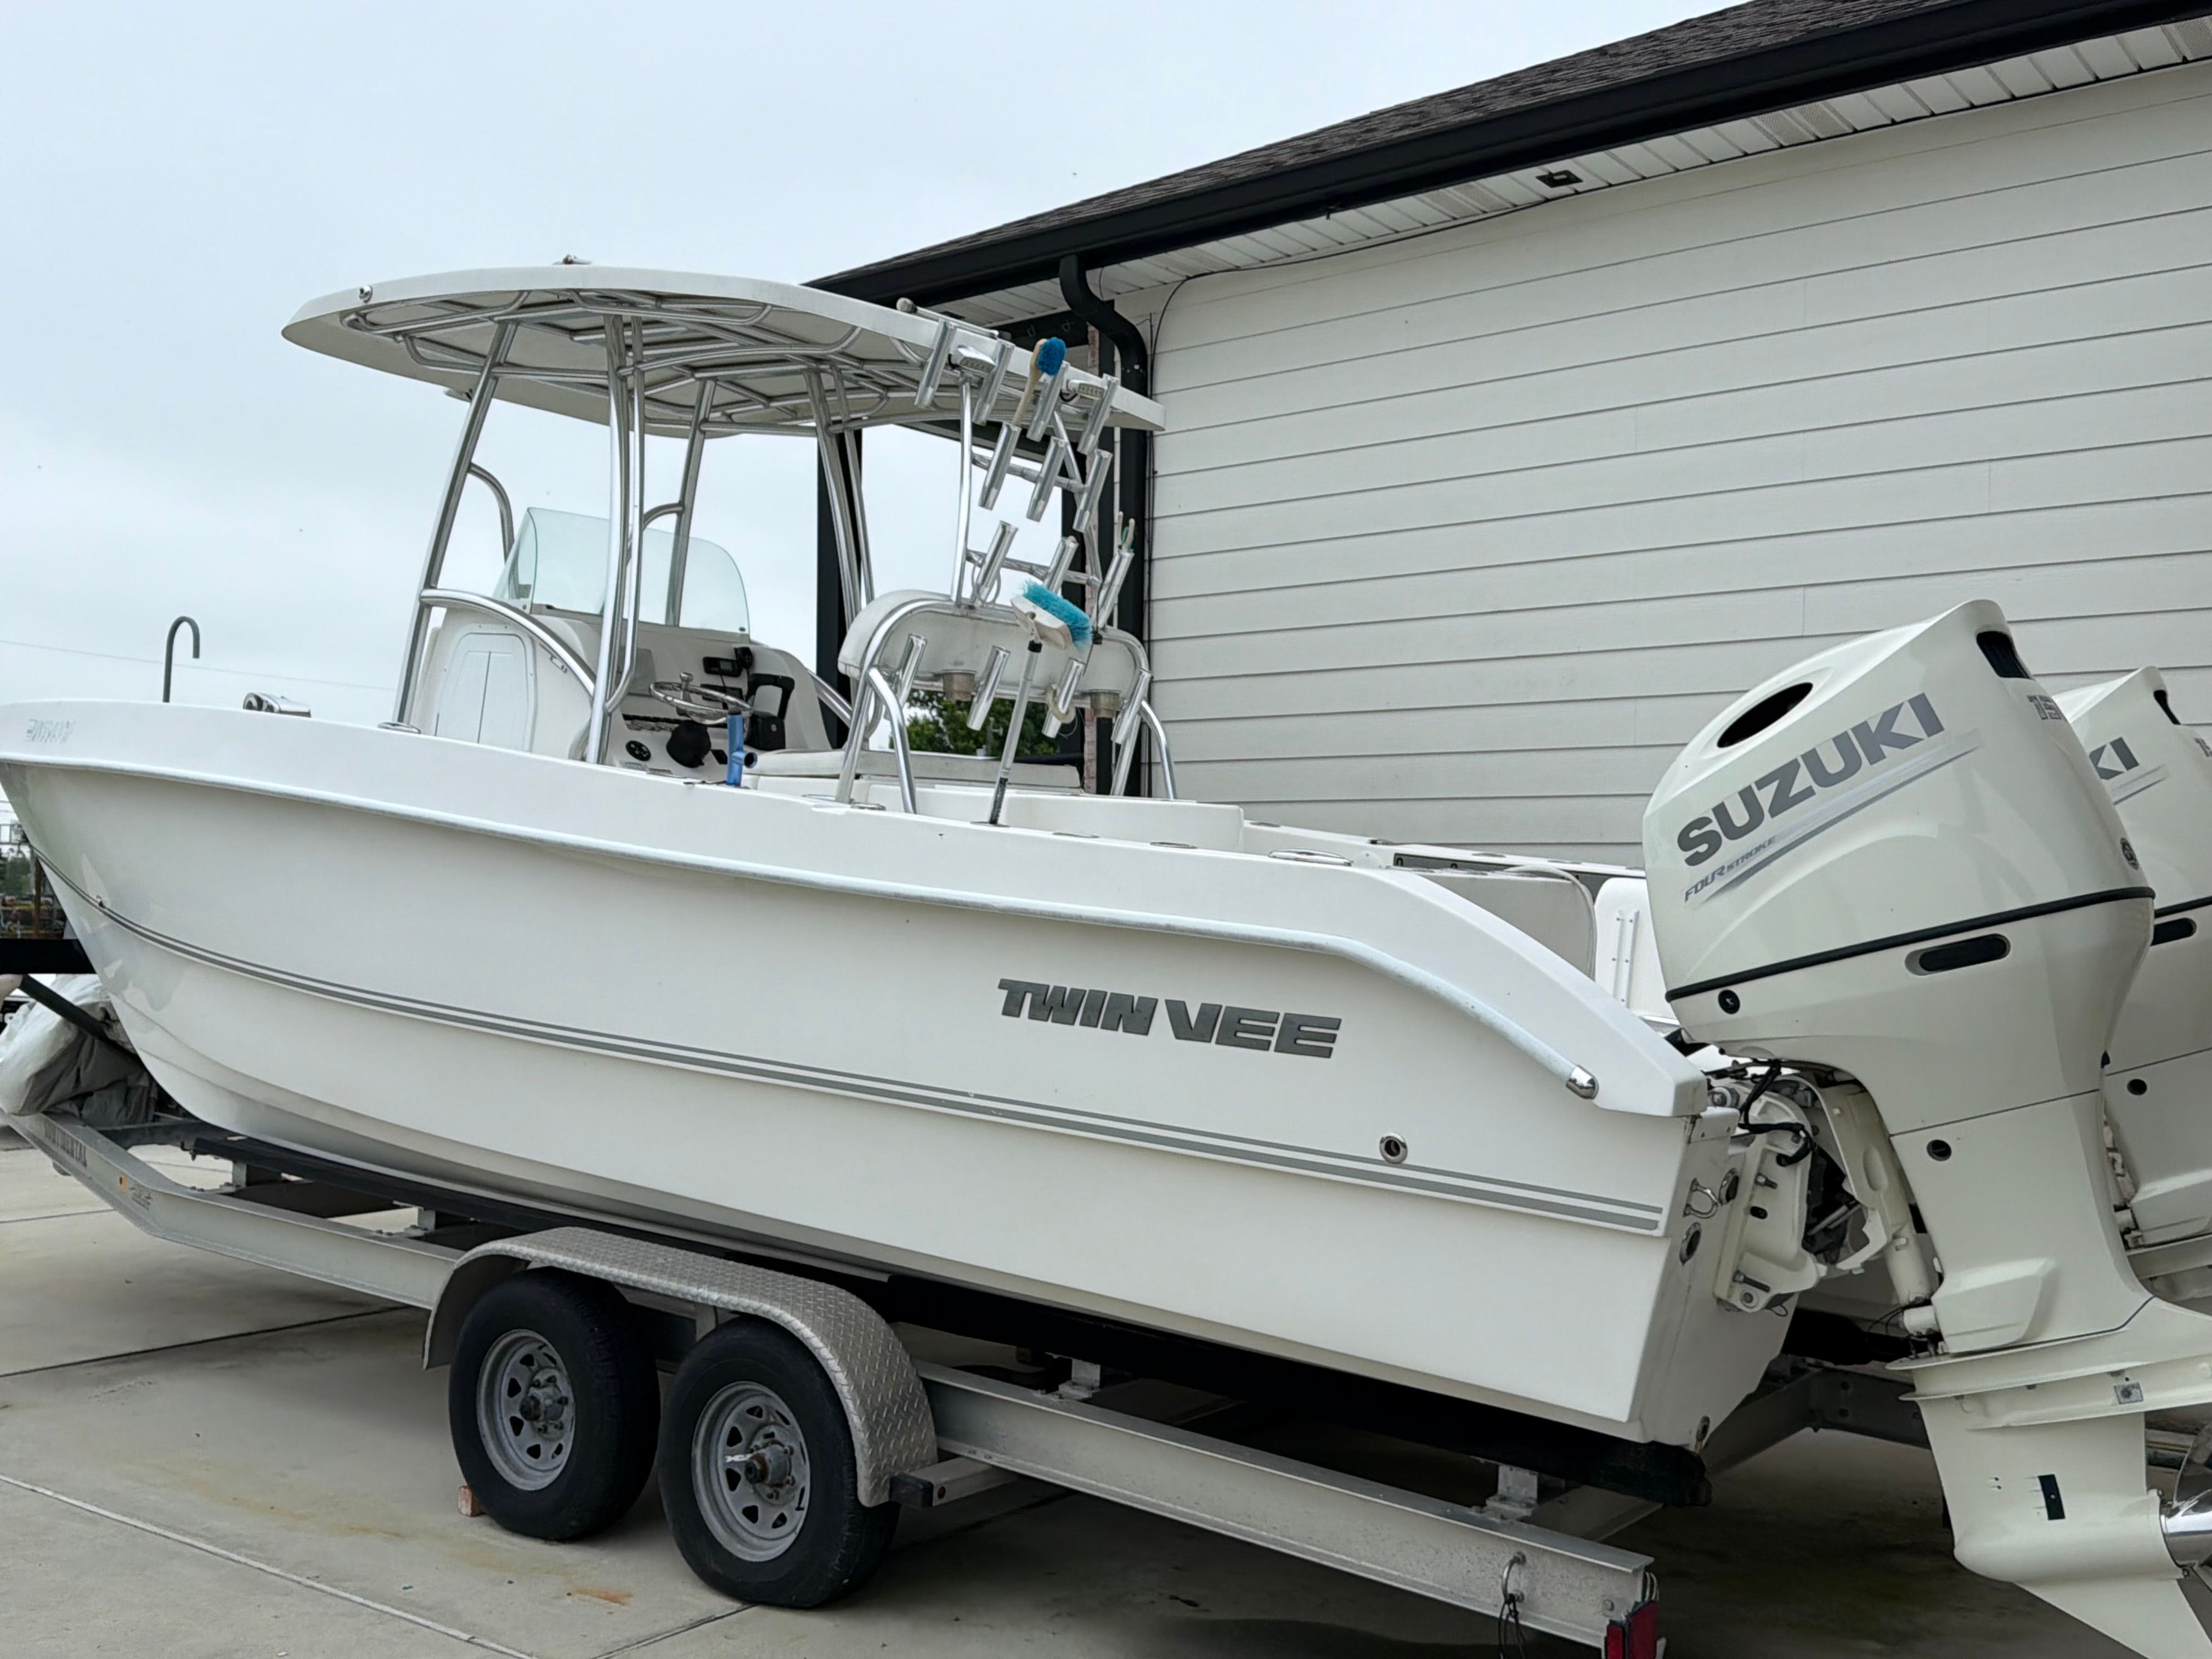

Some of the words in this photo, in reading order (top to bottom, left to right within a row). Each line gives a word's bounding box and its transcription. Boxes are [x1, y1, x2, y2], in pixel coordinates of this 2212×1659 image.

[1678, 693, 1944, 866] SUZUKI
[1685, 865, 1725, 902] FOUR
[1726, 836, 1775, 871] STROKE
[998, 979, 1158, 1036] TWIN
[1165, 999, 1342, 1058] VEE
